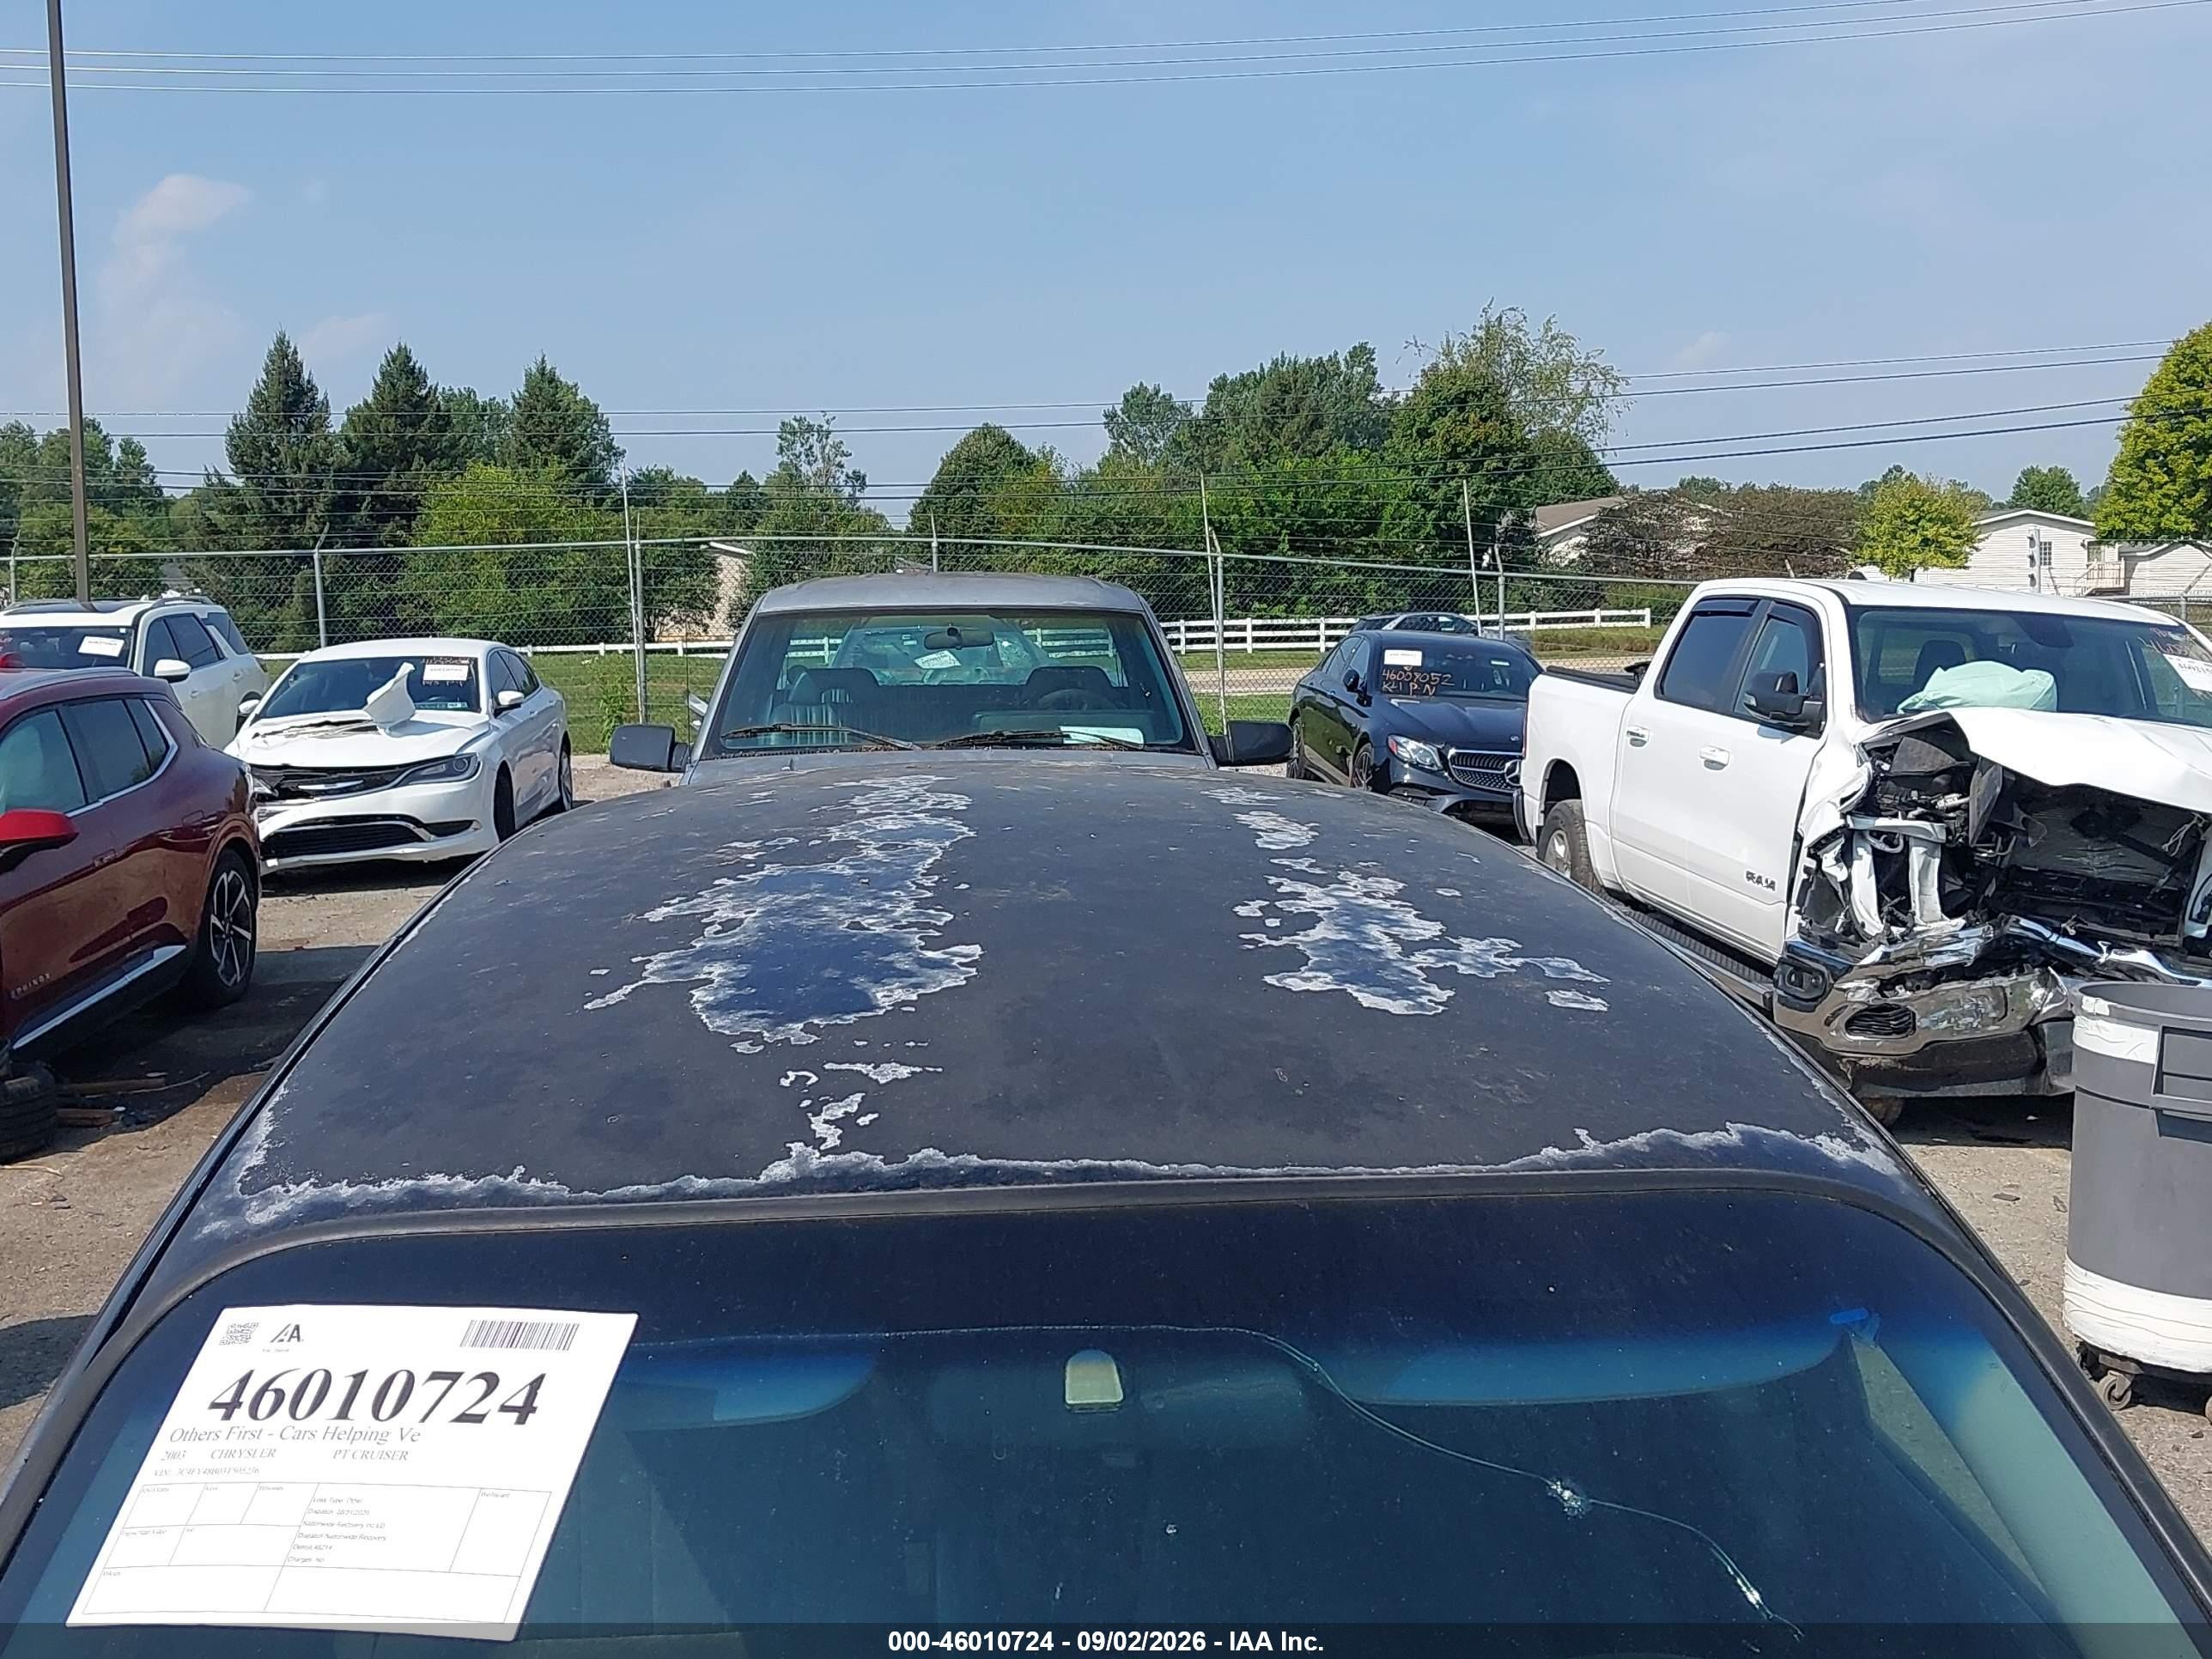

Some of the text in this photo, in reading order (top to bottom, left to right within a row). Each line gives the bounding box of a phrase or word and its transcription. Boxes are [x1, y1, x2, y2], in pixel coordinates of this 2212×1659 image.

[1746, 870, 1776, 891] RAM
[207, 1368, 547, 1425] 46010724
[170, 1427, 220, 1443] Others
[226, 1426, 263, 1440] First
[280, 1425, 317, 1441] Cars
[322, 1426, 392, 1445] Helping
[399, 1427, 421, 1443] Ve
[210, 1448, 276, 1460] CHRYSLER
[333, 1449, 409, 1461] PT CRUISER
